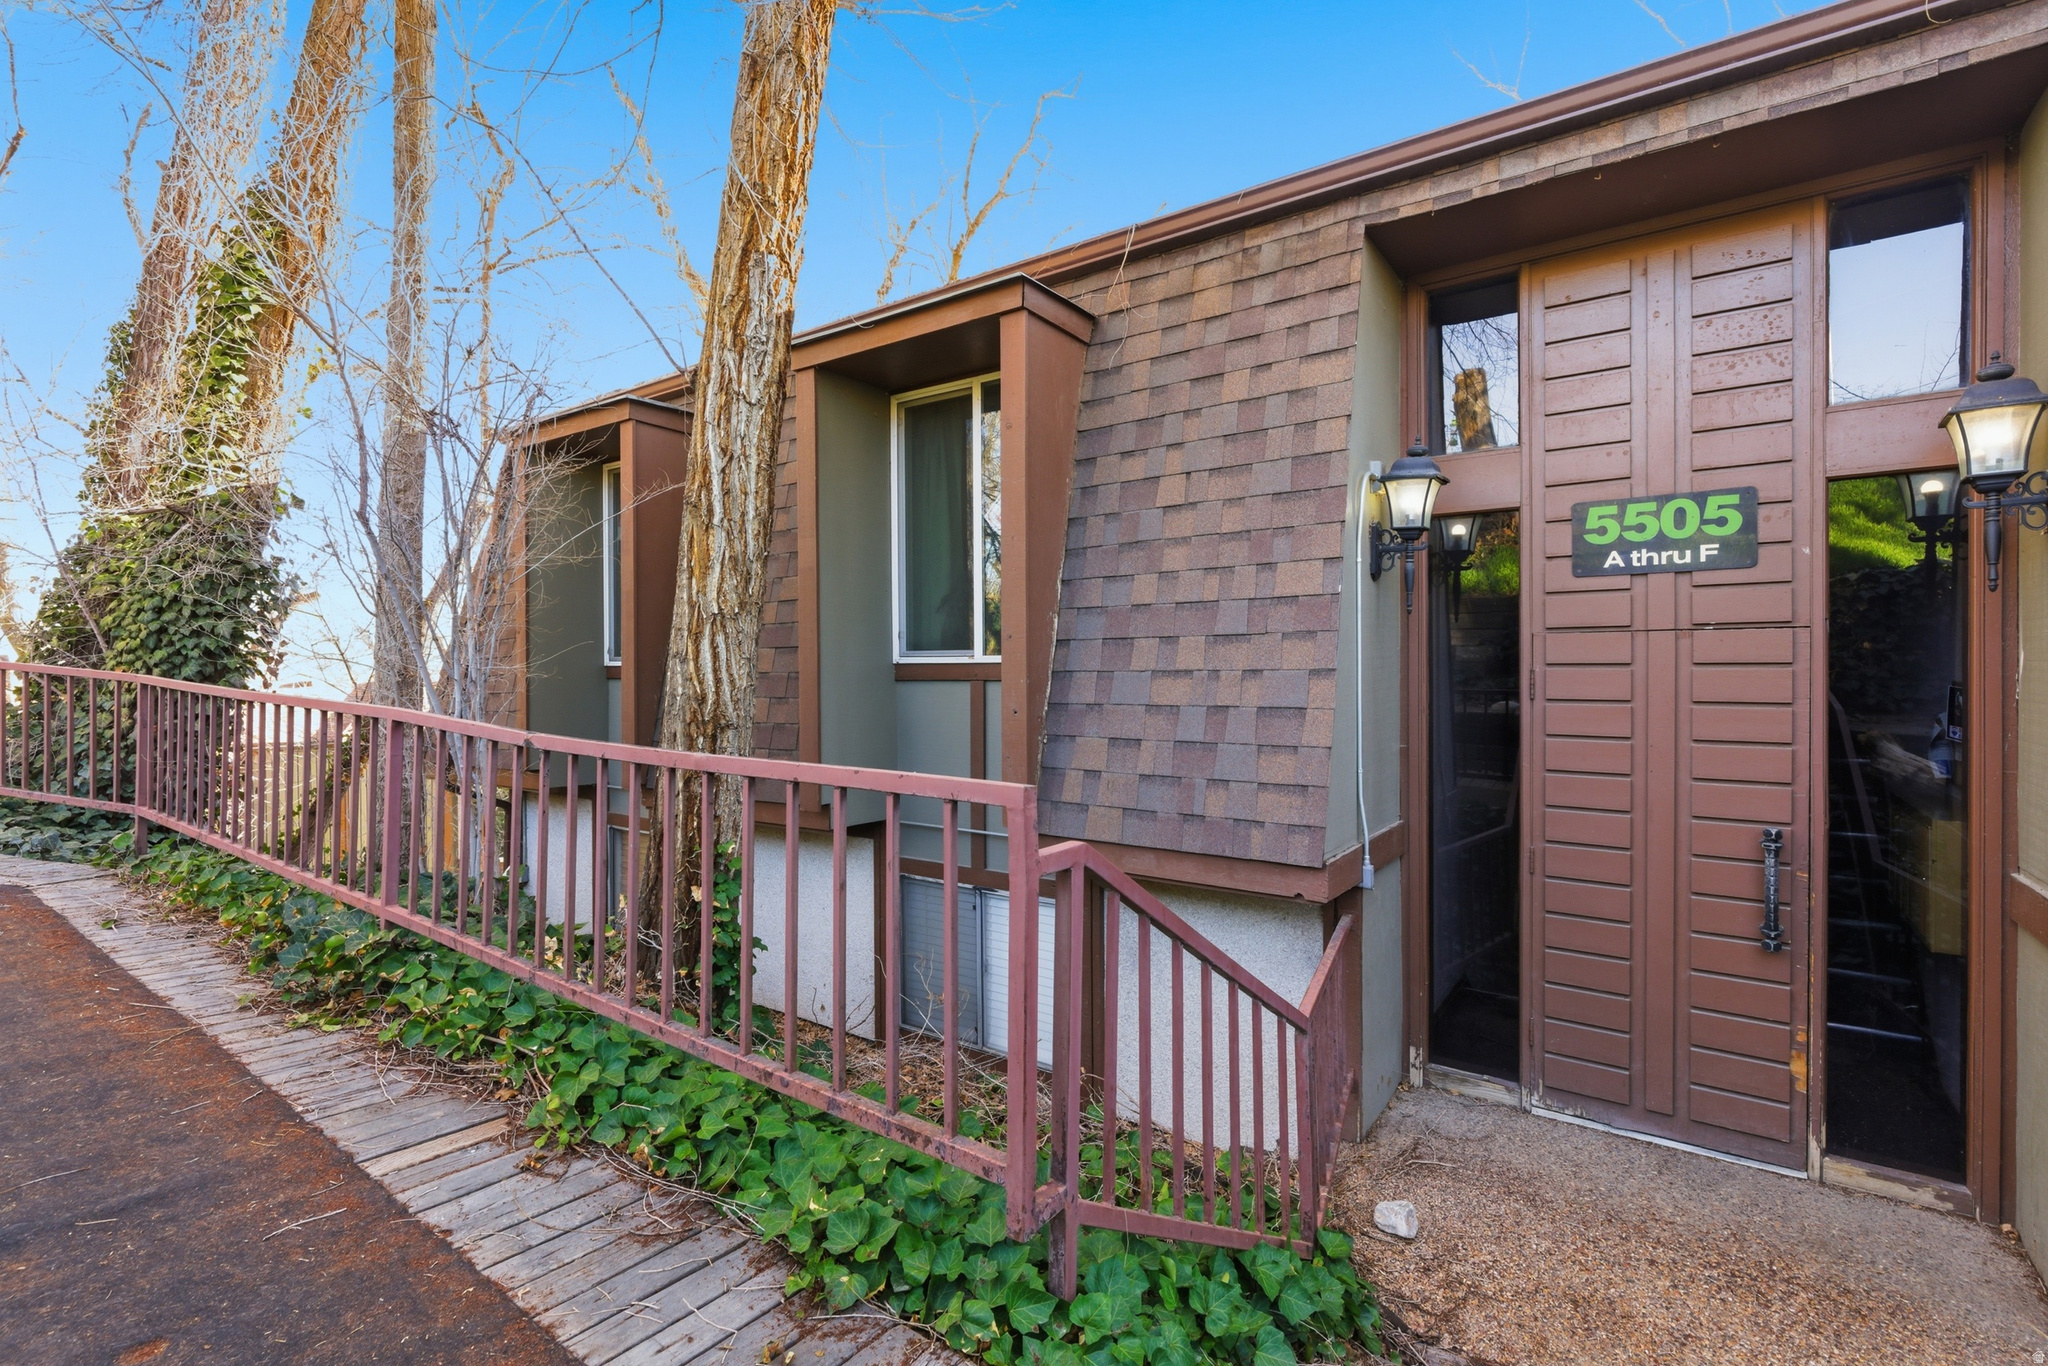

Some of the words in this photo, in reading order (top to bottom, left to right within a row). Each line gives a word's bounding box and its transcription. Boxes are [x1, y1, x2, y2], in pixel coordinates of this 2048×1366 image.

[1583, 494, 1743, 545] 5505
[1603, 550, 1625, 568] A
[1630, 549, 1691, 566] thru
[1699, 543, 1720, 562] F
